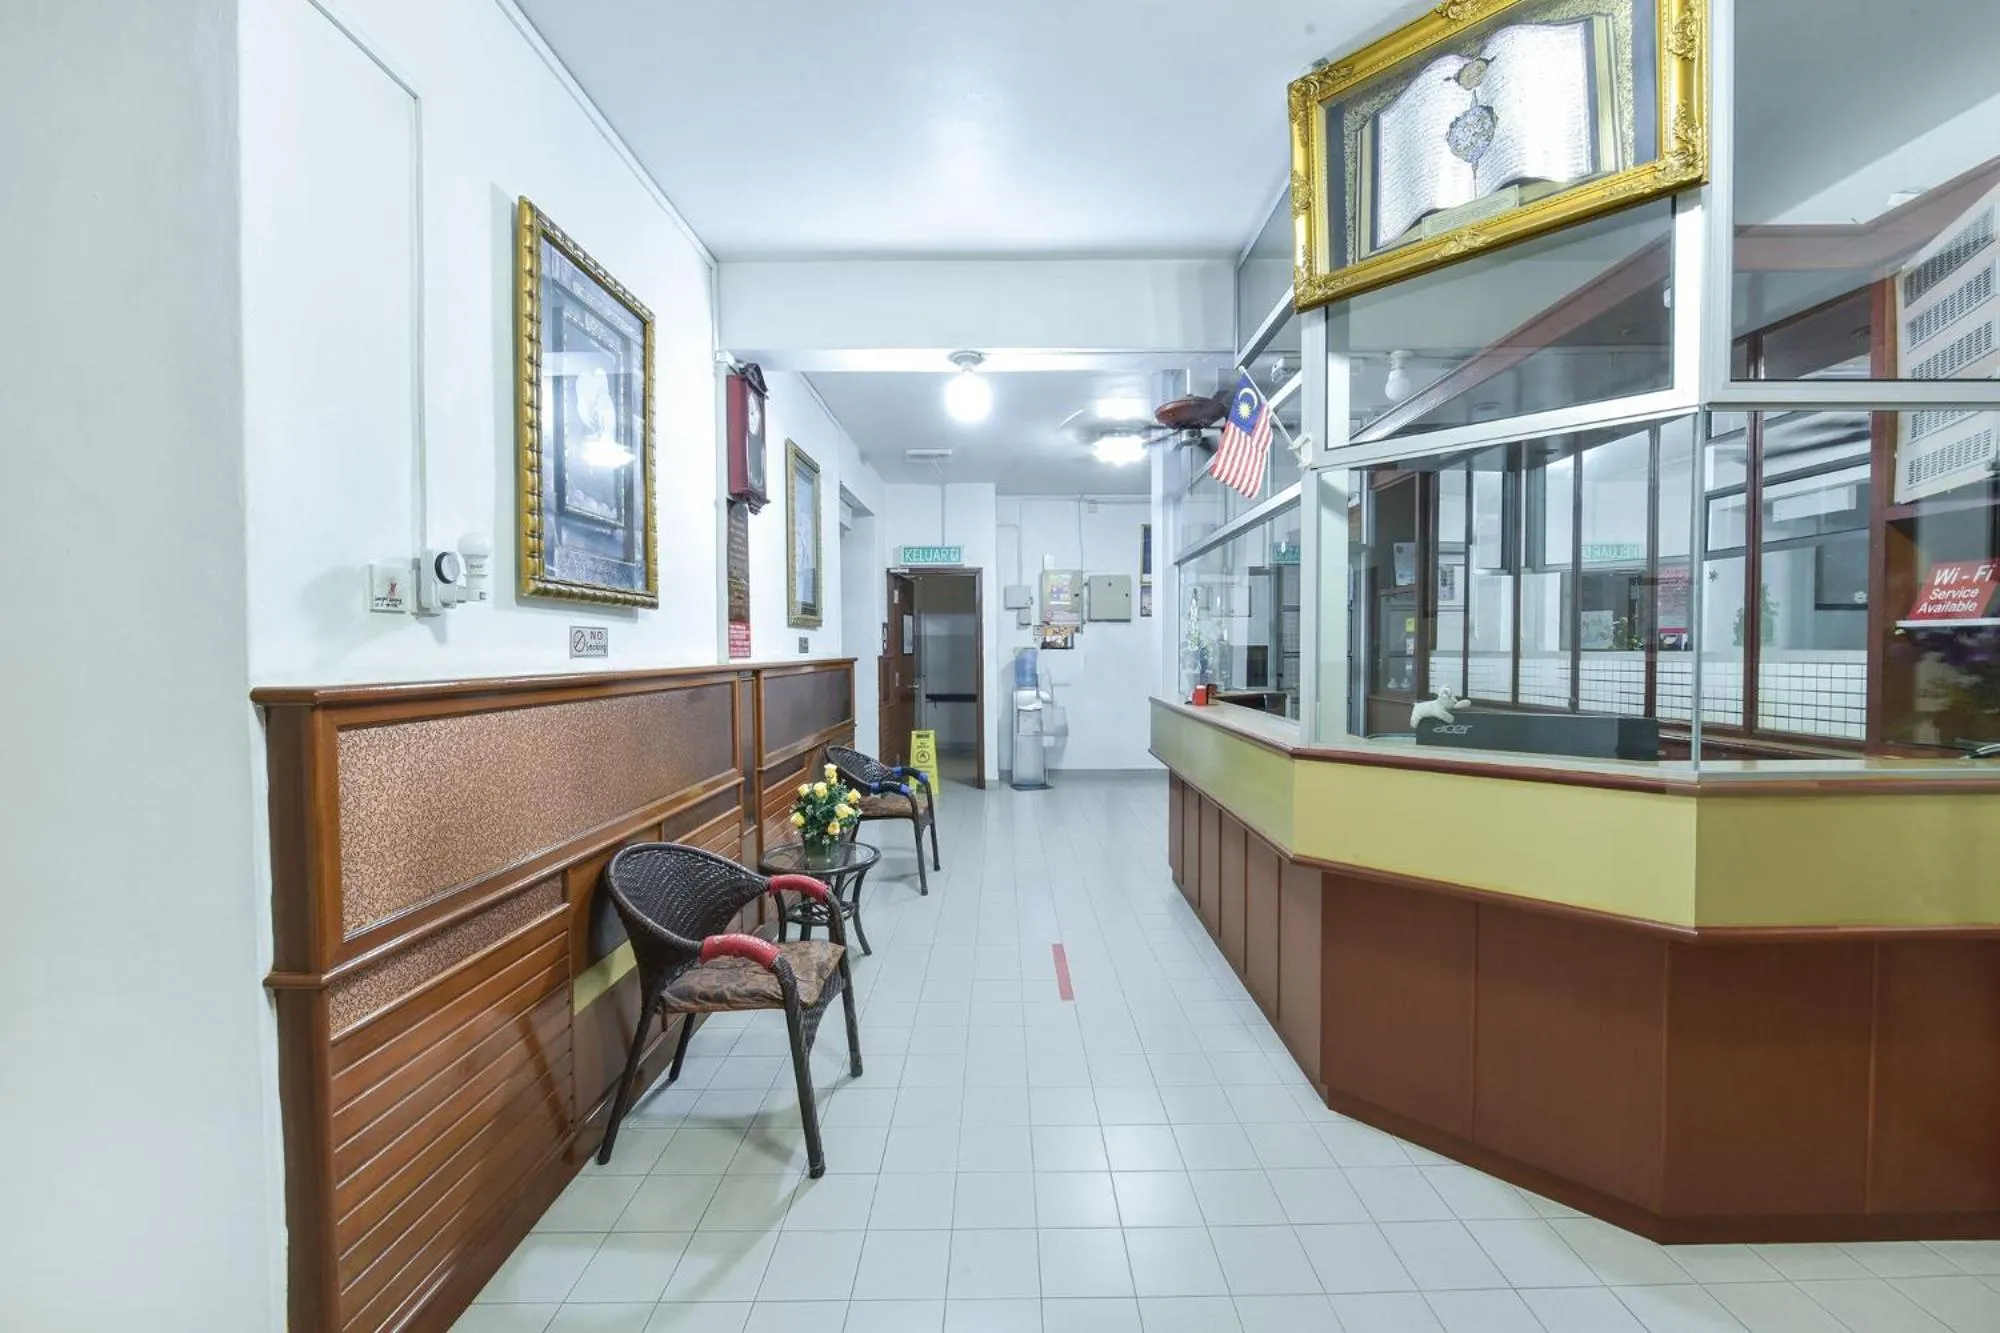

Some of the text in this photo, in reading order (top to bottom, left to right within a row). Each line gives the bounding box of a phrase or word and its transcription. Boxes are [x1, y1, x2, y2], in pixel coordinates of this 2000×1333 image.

[905, 548, 949, 562] KELUAR
[1929, 586, 1980, 601] Service
[1917, 600, 1978, 614] Available
[590, 629, 604, 640] NO
[1432, 724, 1473, 735] acer
